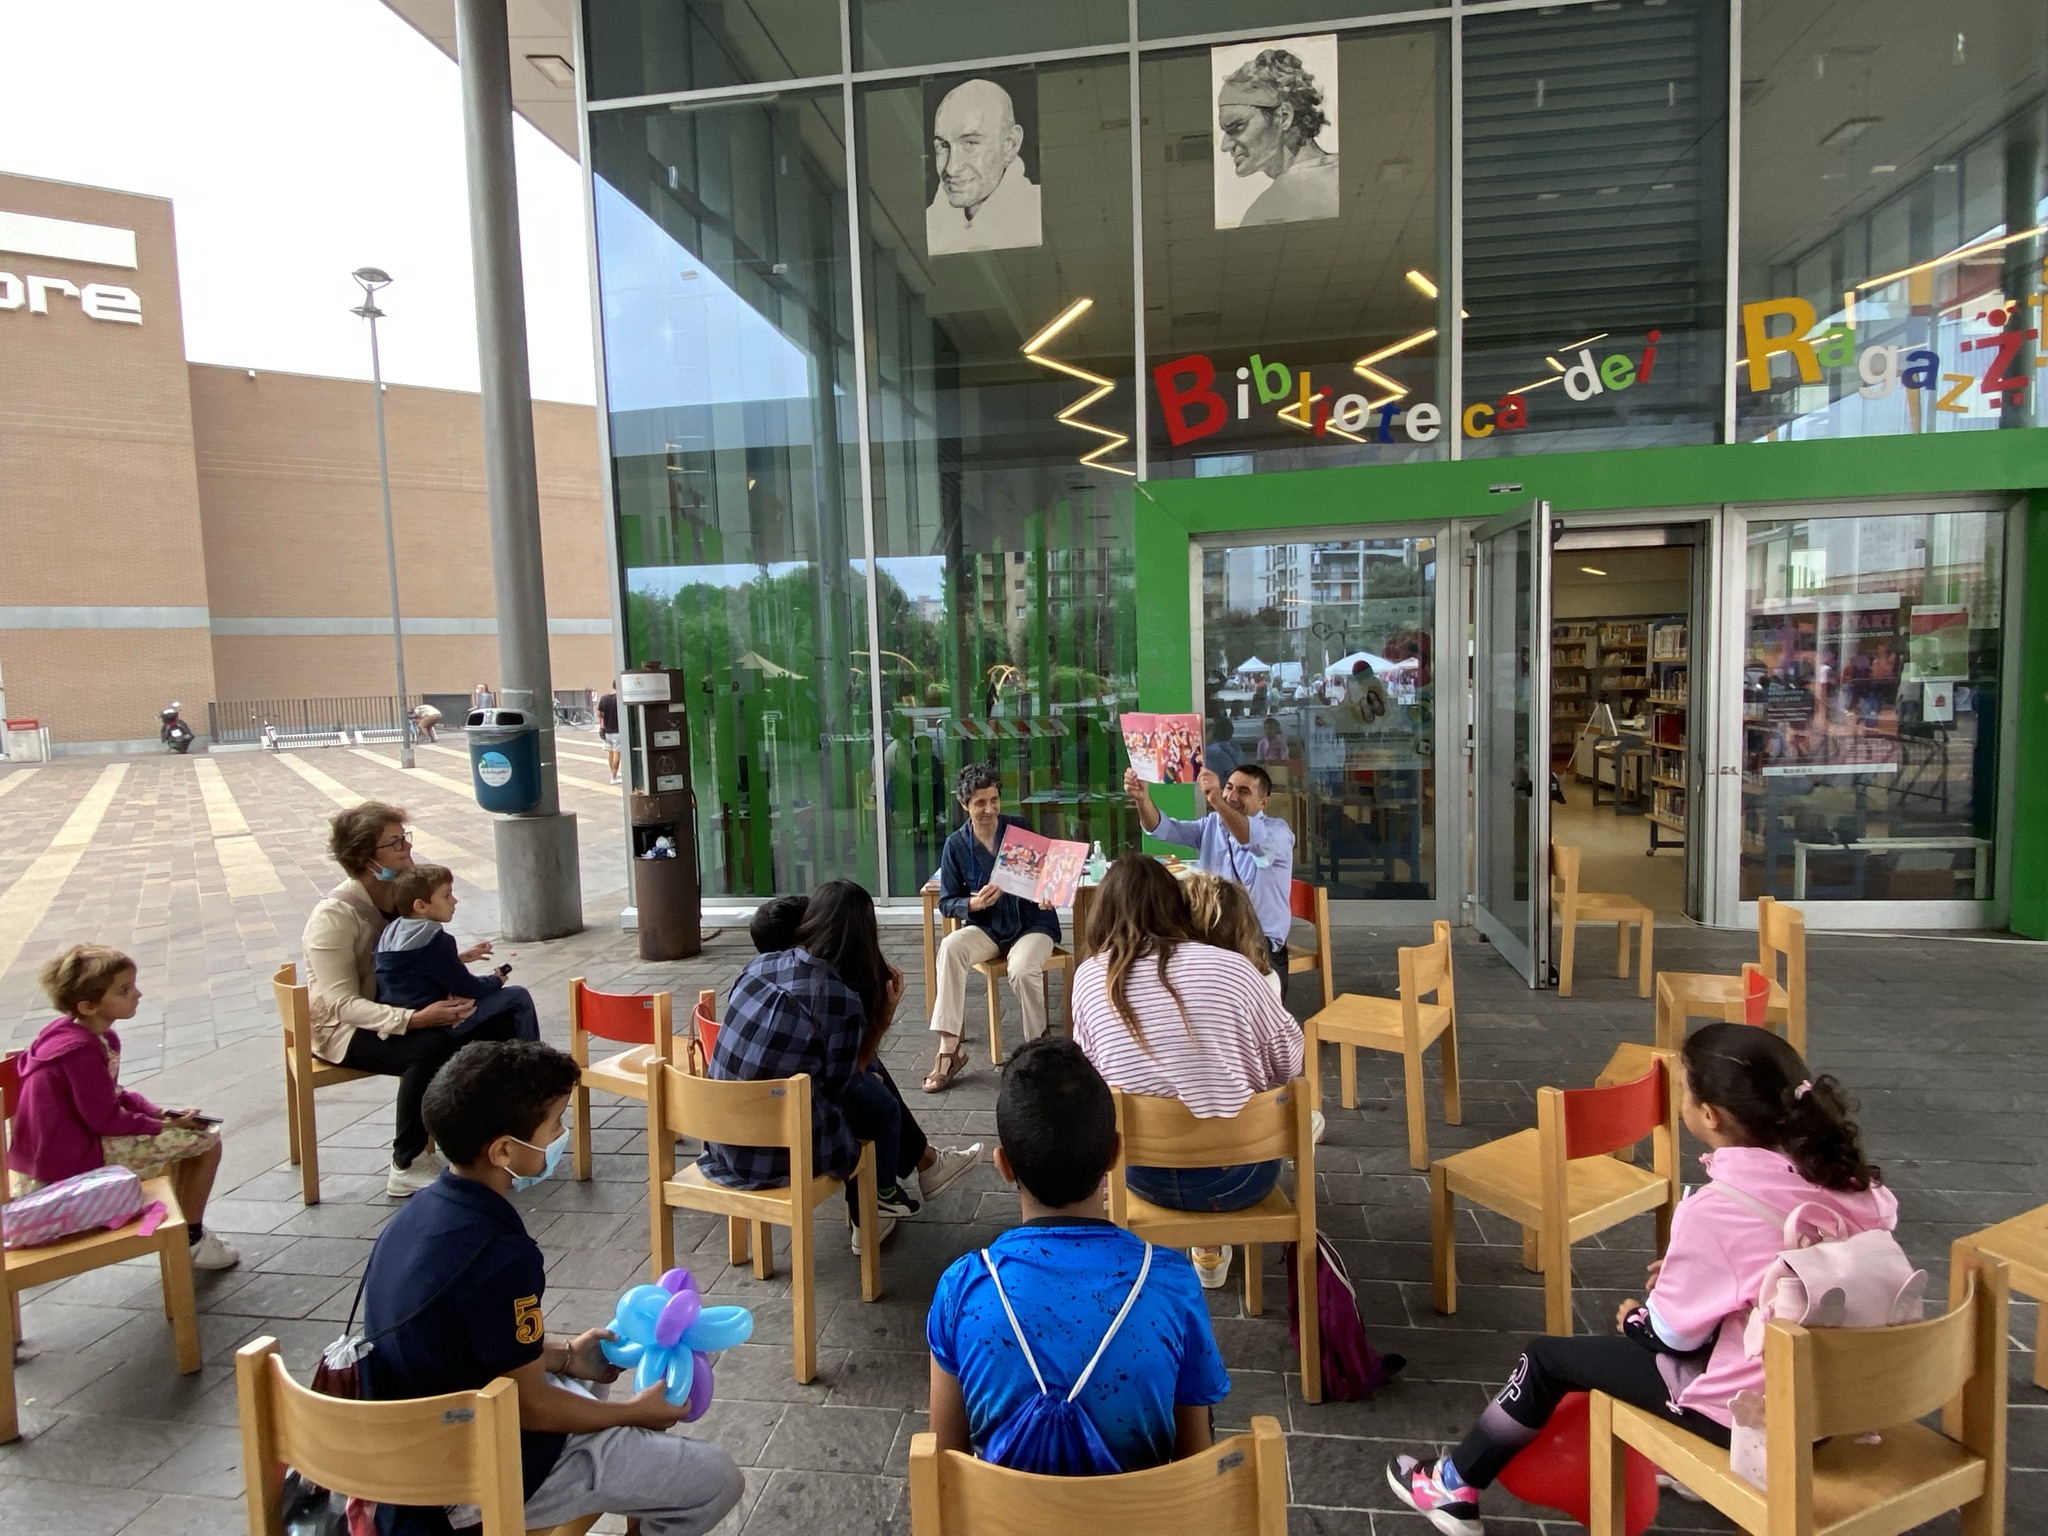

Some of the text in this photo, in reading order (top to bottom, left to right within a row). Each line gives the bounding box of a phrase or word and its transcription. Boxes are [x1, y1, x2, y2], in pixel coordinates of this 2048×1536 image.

[1153, 353, 1528, 447] Biblioteca
[1563, 329, 1661, 401] dei
[514, 1294, 544, 1344] 5
